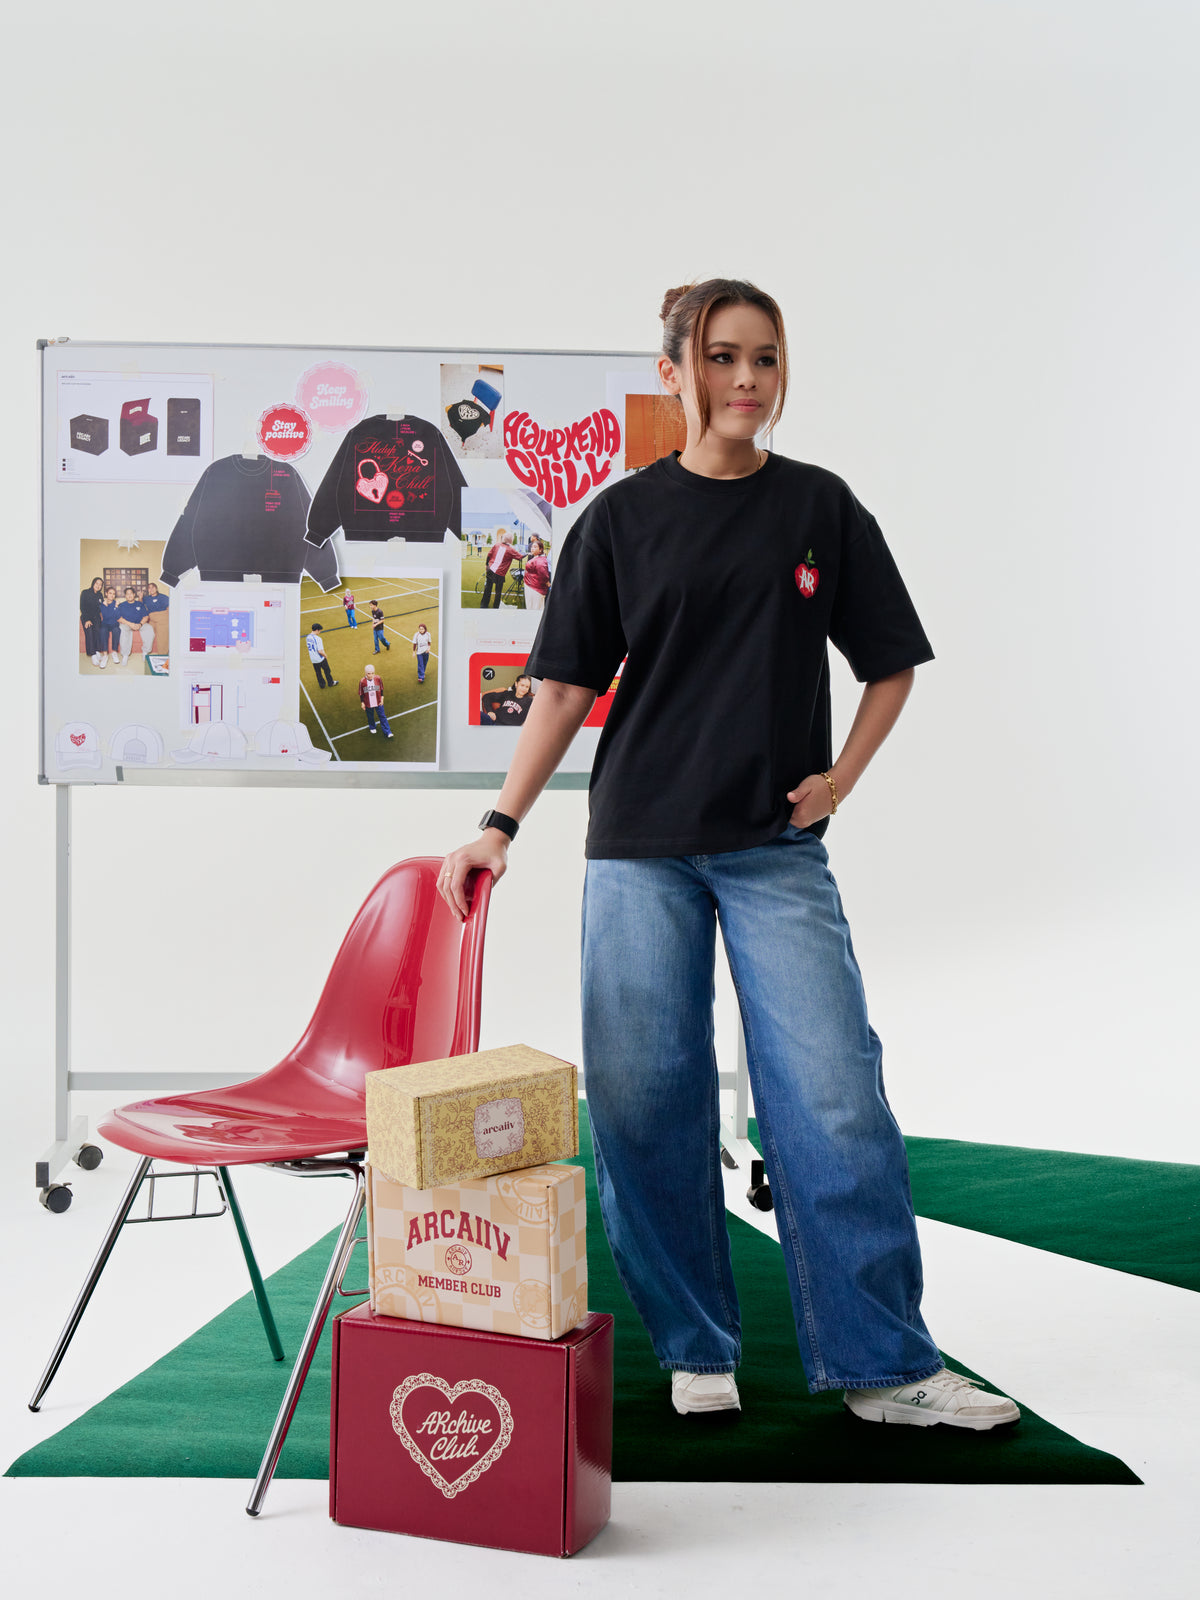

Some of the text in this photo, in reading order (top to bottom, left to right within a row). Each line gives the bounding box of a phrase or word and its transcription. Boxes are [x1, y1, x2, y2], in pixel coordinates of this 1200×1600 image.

[316, 383, 347, 398] Keep
[309, 396, 355, 409] Smiling
[265, 429, 304, 441] positive
[272, 419, 297, 431] Stay
[390, 470, 435, 490] Chill
[799, 567, 815, 593] AR
[482, 1120, 515, 1136] arcaiiv
[406, 1209, 511, 1262] ARCAIIV
[418, 1275, 501, 1298] MEMBER CLUB
[416, 1409, 493, 1435] ARchive
[430, 1434, 480, 1461] Club
